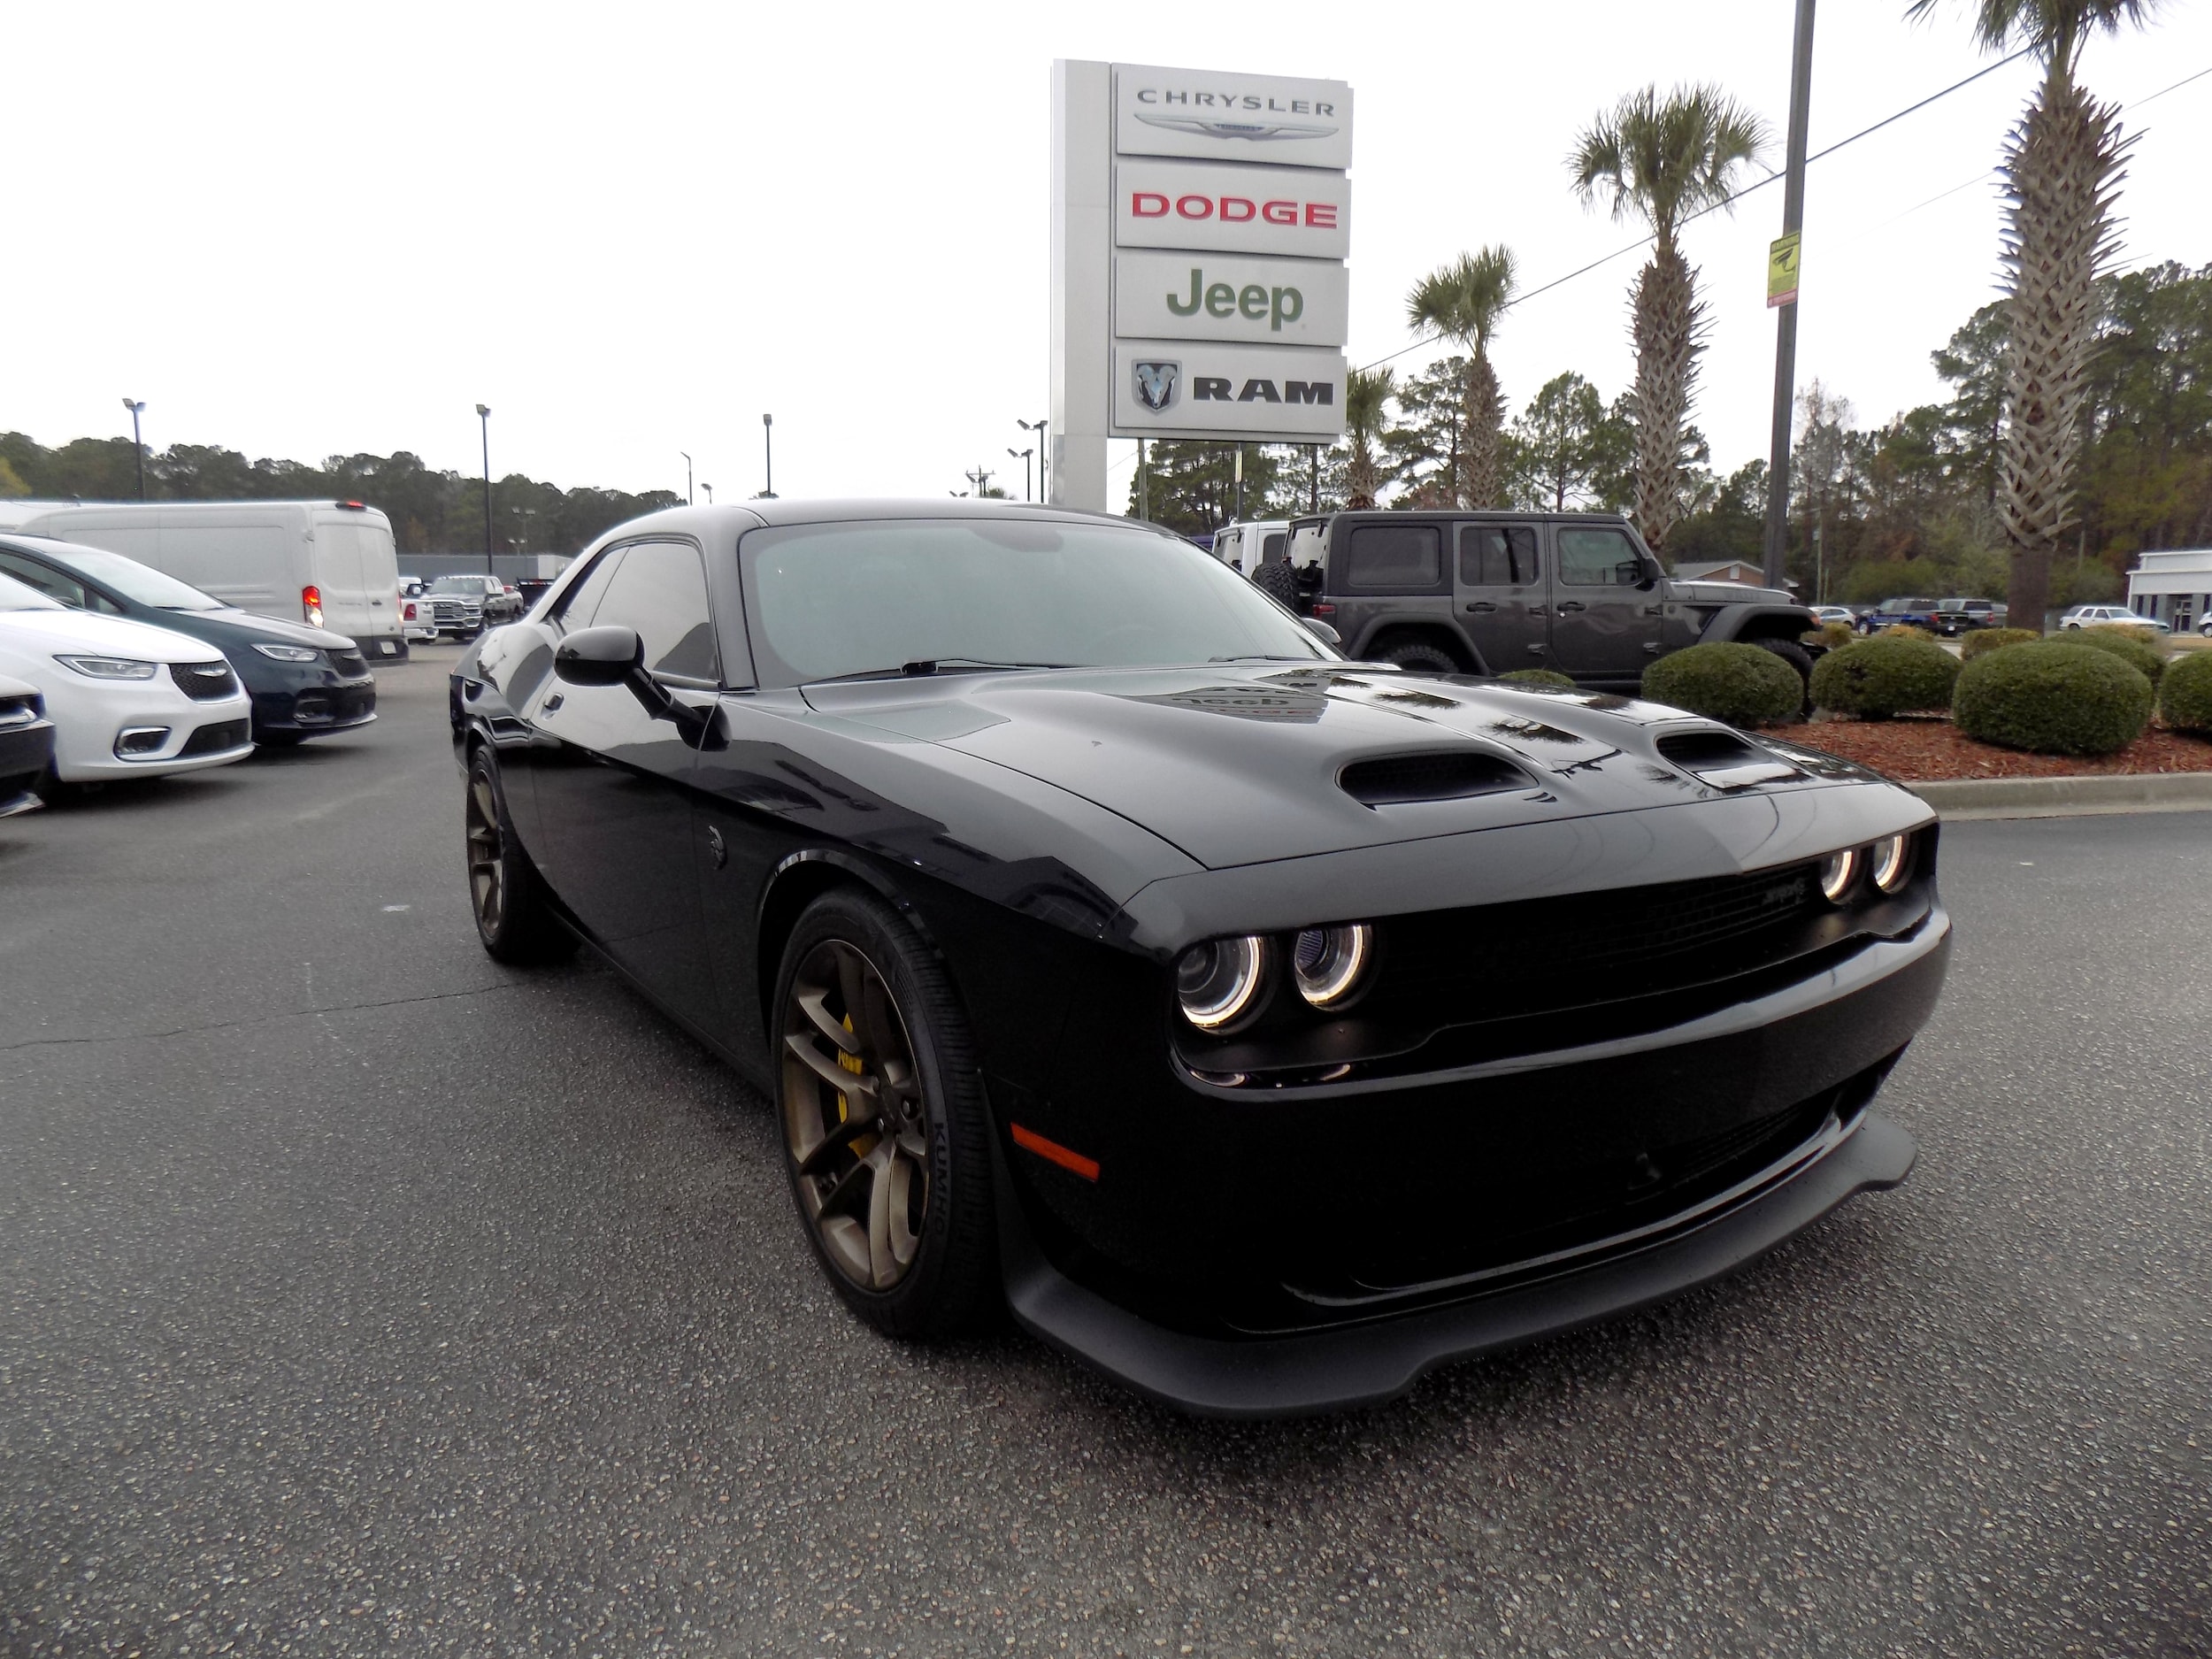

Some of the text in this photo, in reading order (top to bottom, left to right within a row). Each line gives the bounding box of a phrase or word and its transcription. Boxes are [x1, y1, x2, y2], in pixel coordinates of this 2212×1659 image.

[1137, 89, 1334, 117] CHRYSLER
[1132, 192, 1338, 229] DODGE
[1167, 268, 1304, 331] Jeep
[1194, 377, 1333, 406] RAM
[933, 1122, 949, 1235] KUMHO
